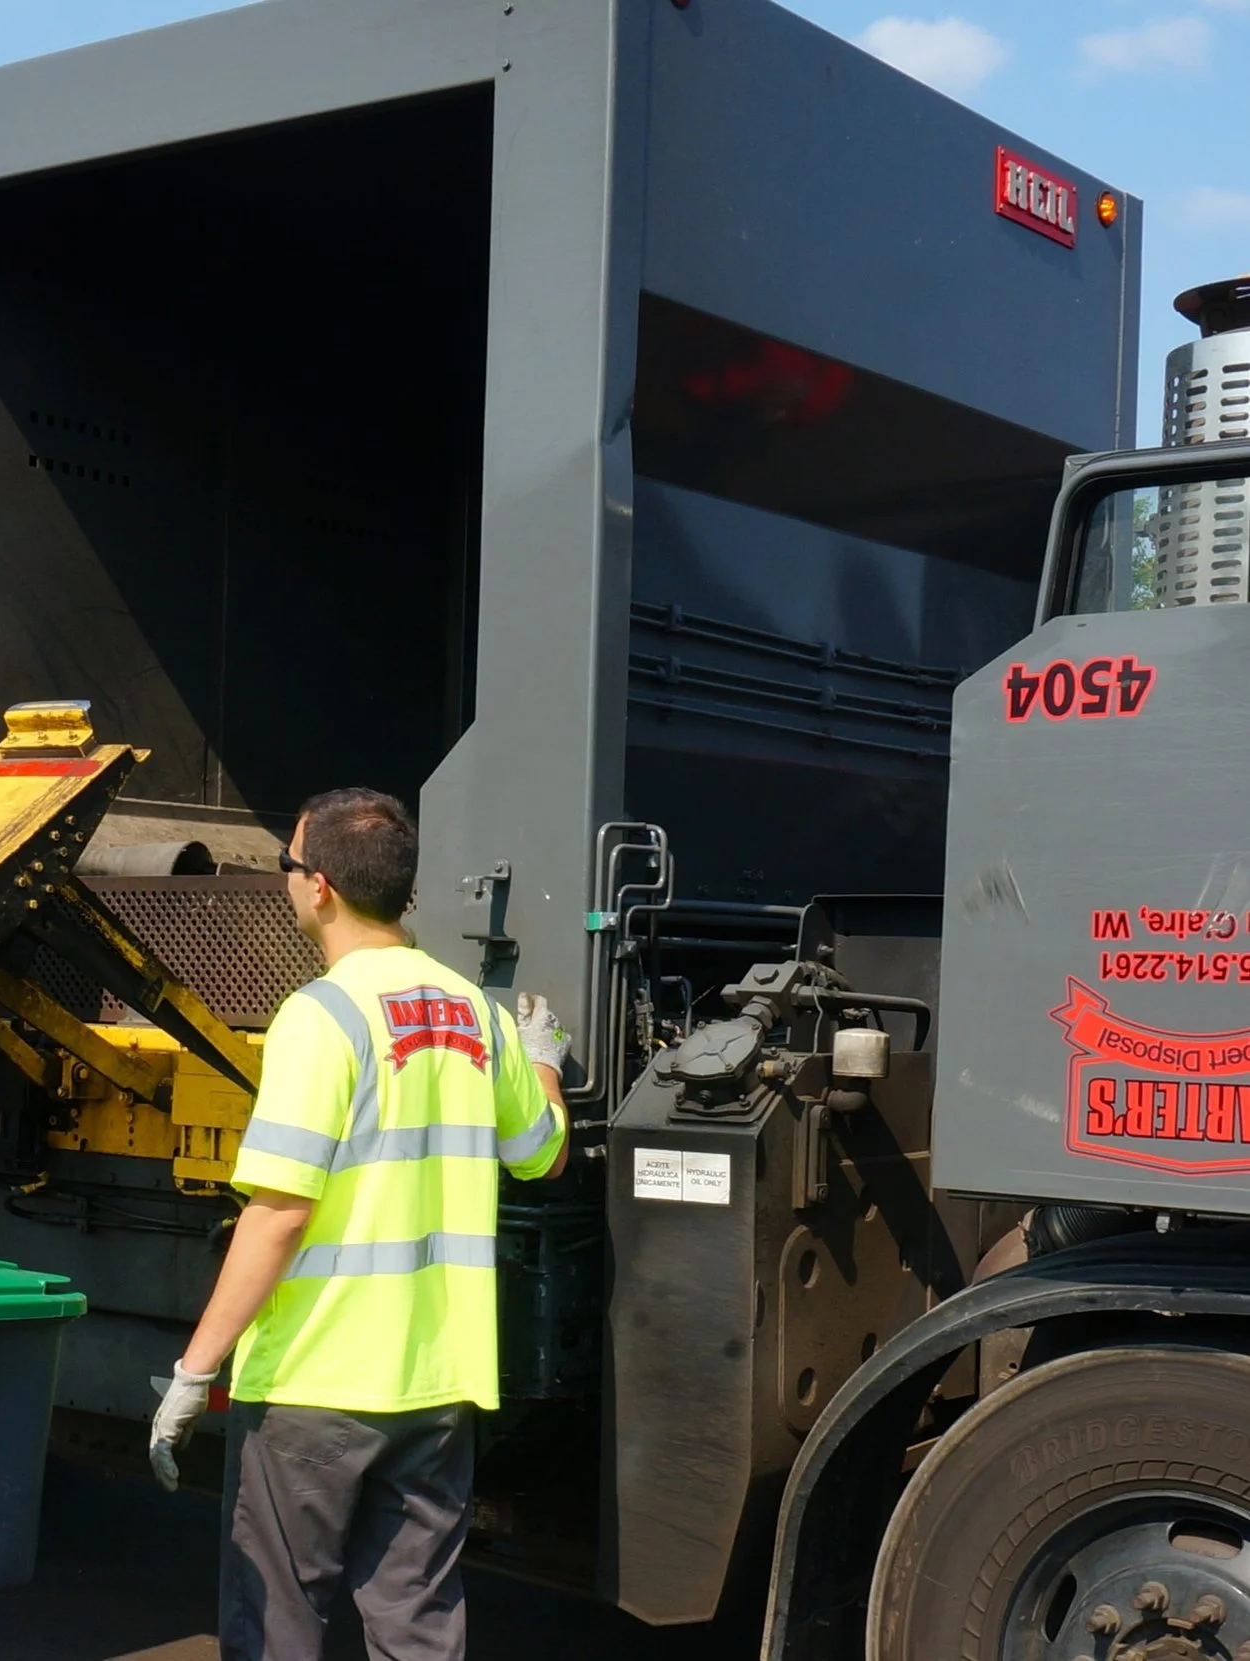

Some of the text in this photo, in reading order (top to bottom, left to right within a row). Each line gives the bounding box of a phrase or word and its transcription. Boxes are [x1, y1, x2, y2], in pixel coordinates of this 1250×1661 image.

[1006, 161, 1075, 234] HEIL
[1006, 658, 1153, 720] 4504
[1093, 911, 1131, 938] WI
[1097, 1028, 1200, 1072] Disposal
[686, 1168, 727, 1178] HYDRAULIC
[703, 1179, 722, 1187] ONLY
